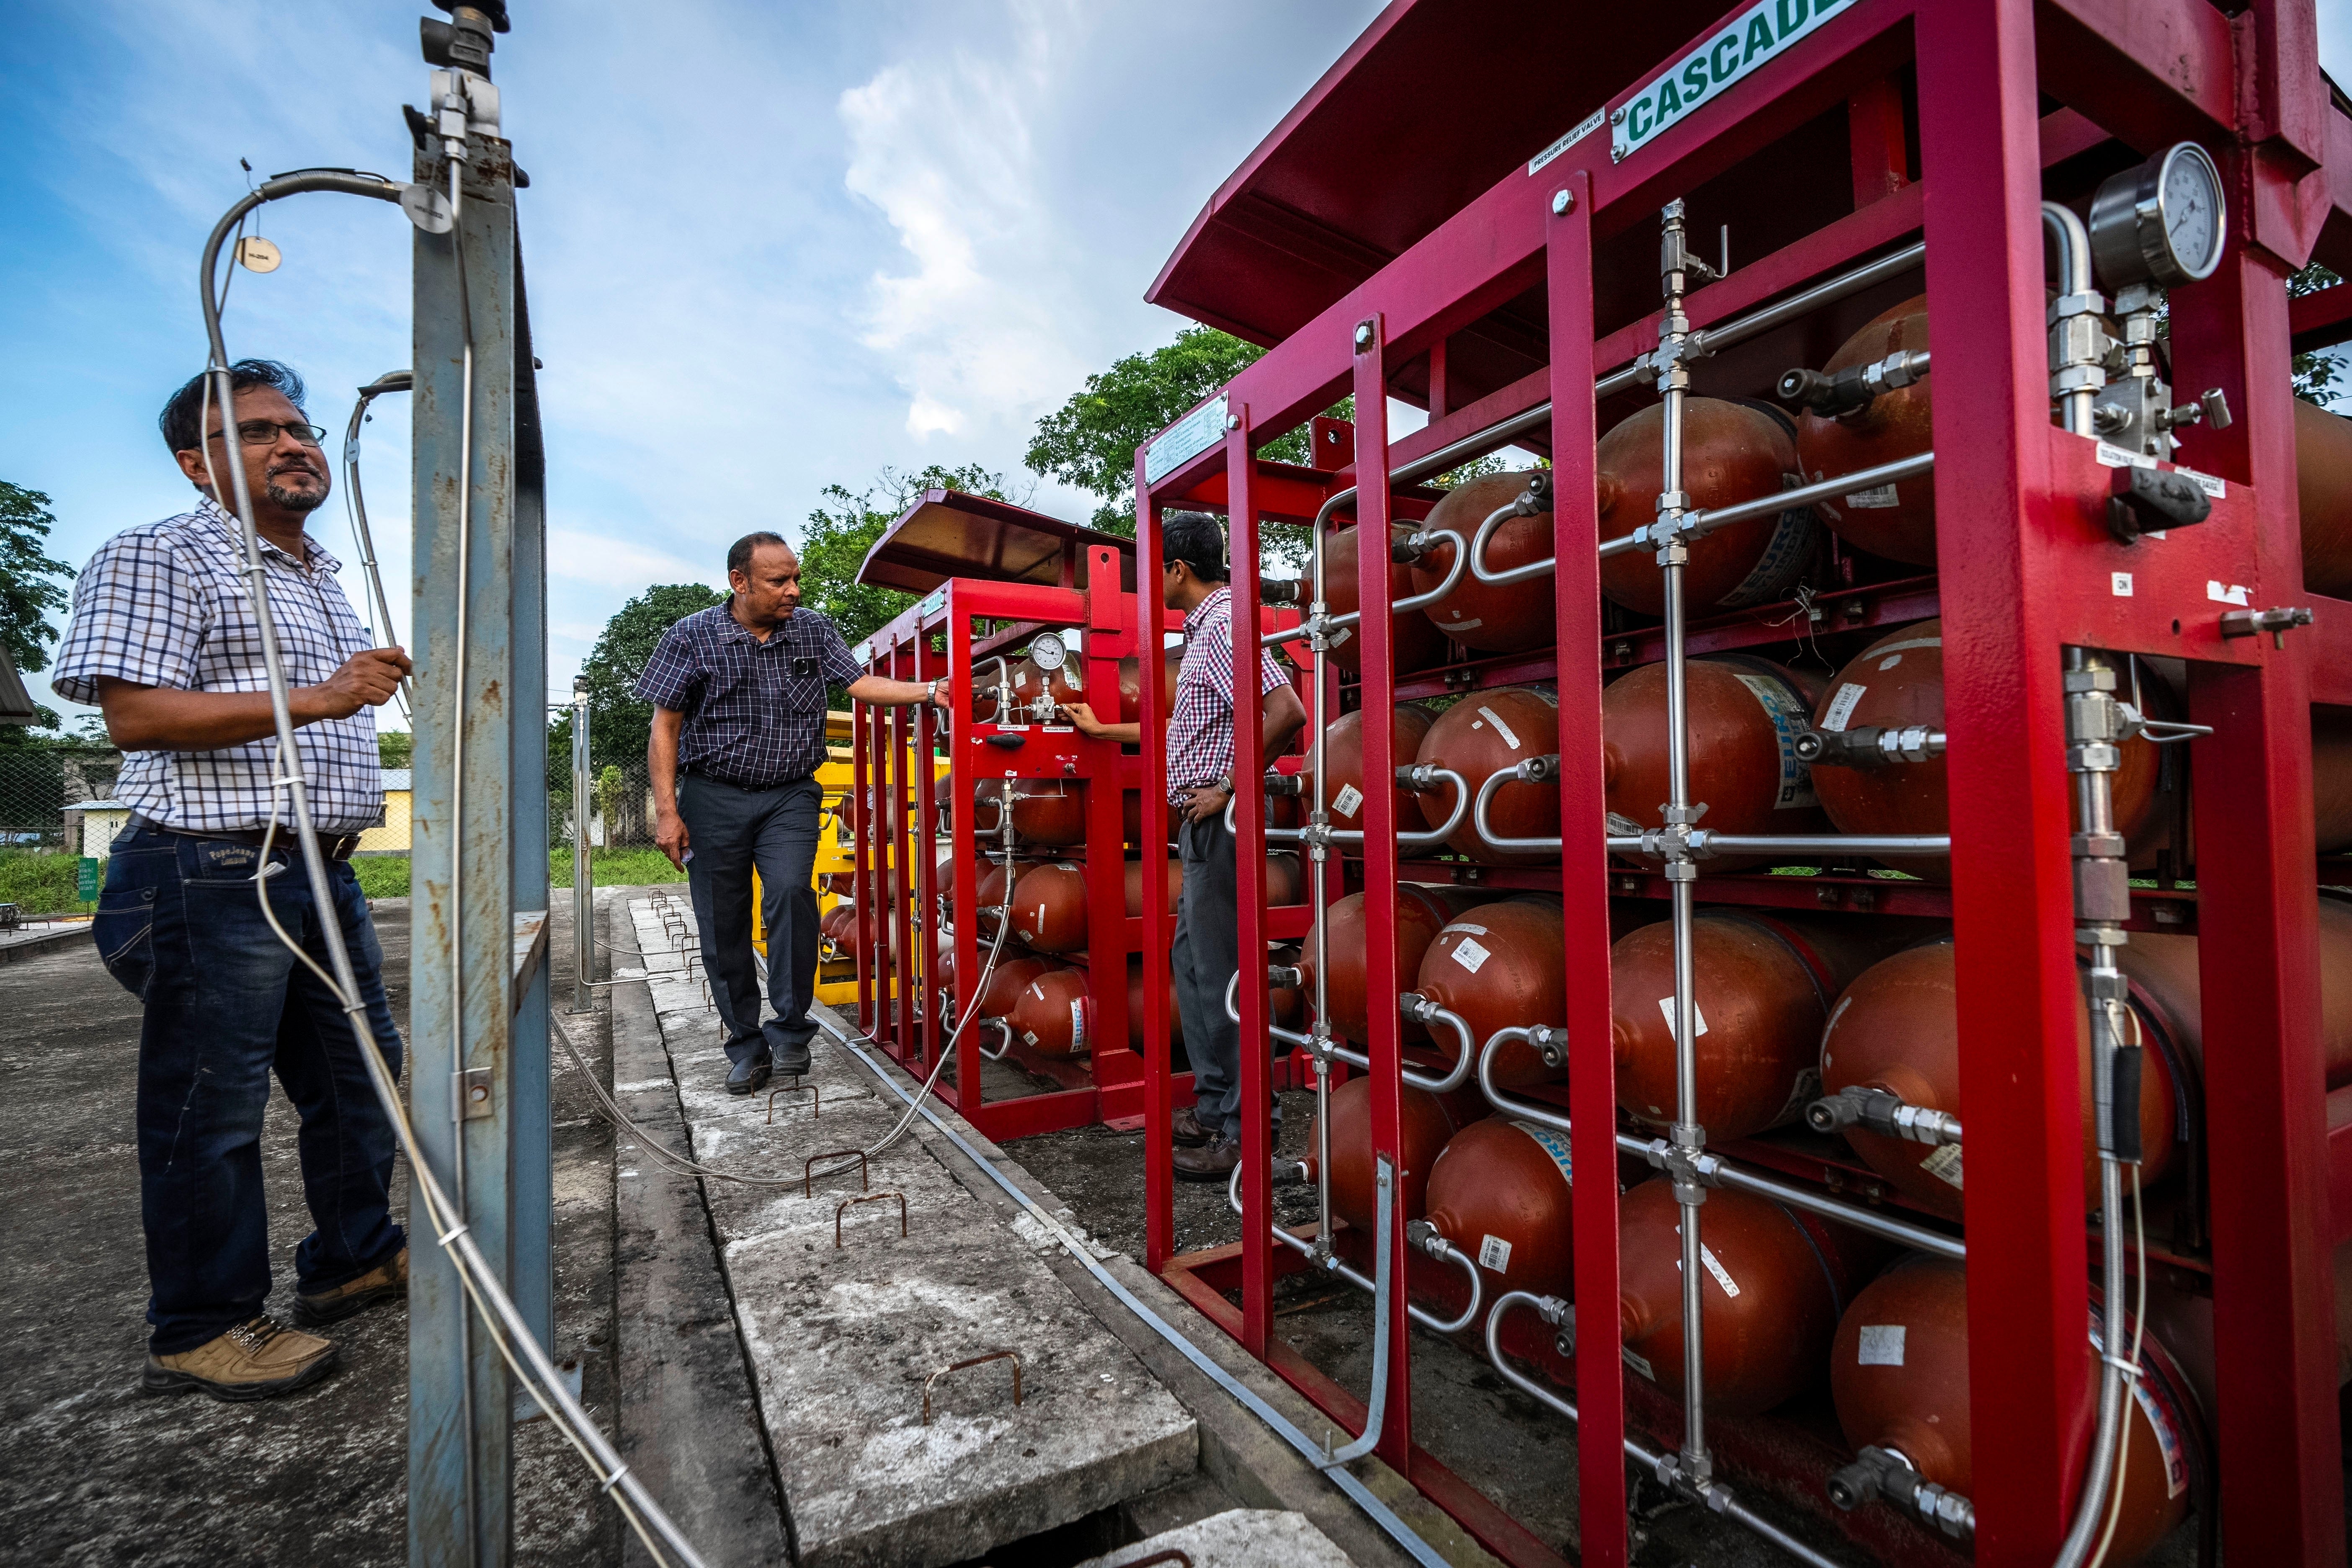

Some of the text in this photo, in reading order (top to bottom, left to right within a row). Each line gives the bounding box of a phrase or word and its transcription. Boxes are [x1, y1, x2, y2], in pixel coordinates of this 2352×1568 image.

[1534, 113, 1601, 168] PRESSURE RELIEF VALVE
[1761, 695, 1797, 779] EURO
[1534, 1132, 1571, 1176] URO
